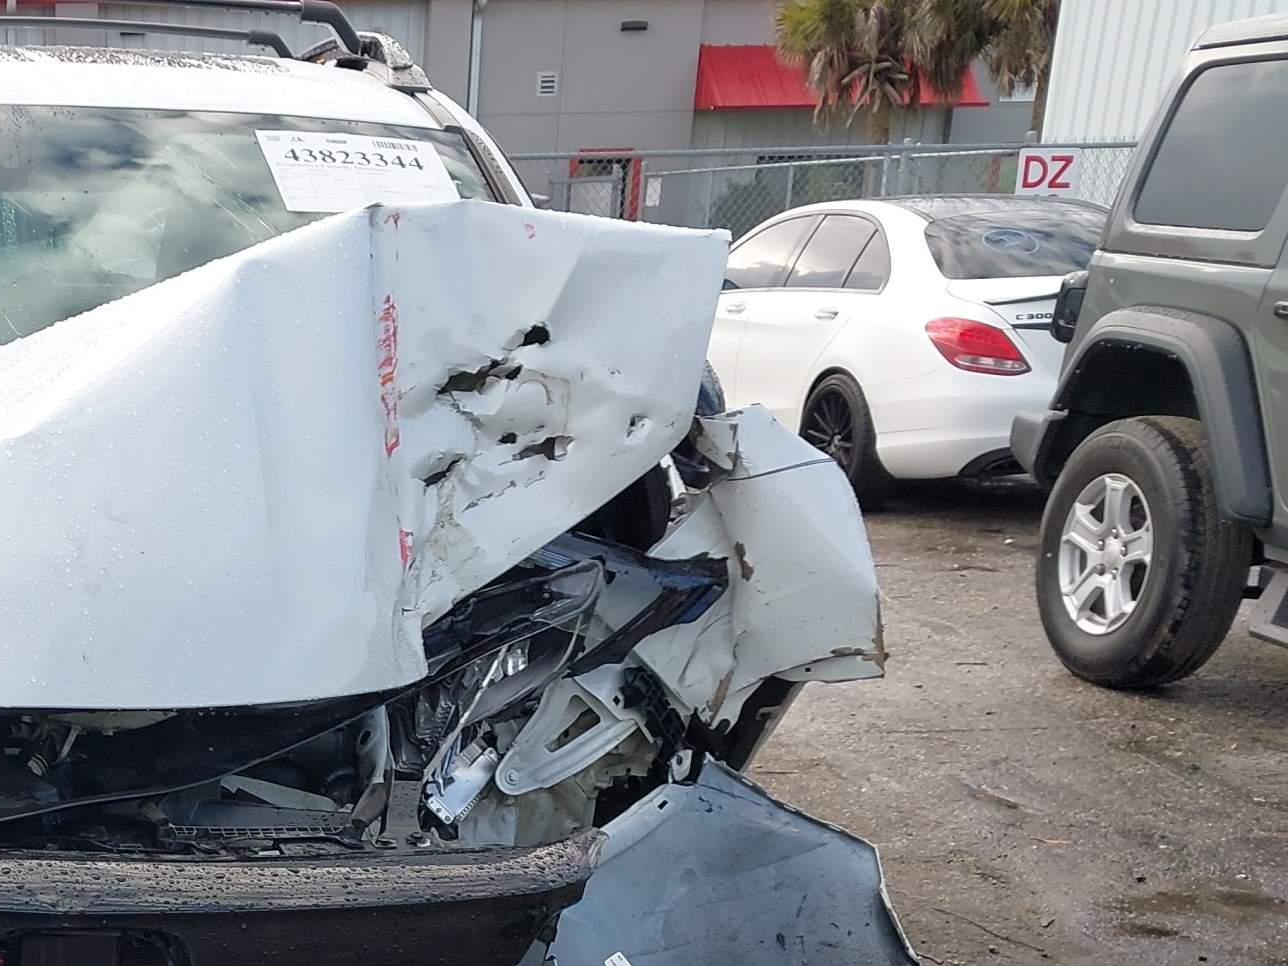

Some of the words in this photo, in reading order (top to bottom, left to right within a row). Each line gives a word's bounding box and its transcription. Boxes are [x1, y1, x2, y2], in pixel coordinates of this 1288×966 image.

[284, 148, 424, 171] 43823344
[1022, 155, 1075, 189] DZ
[1026, 312, 1053, 320] 300
